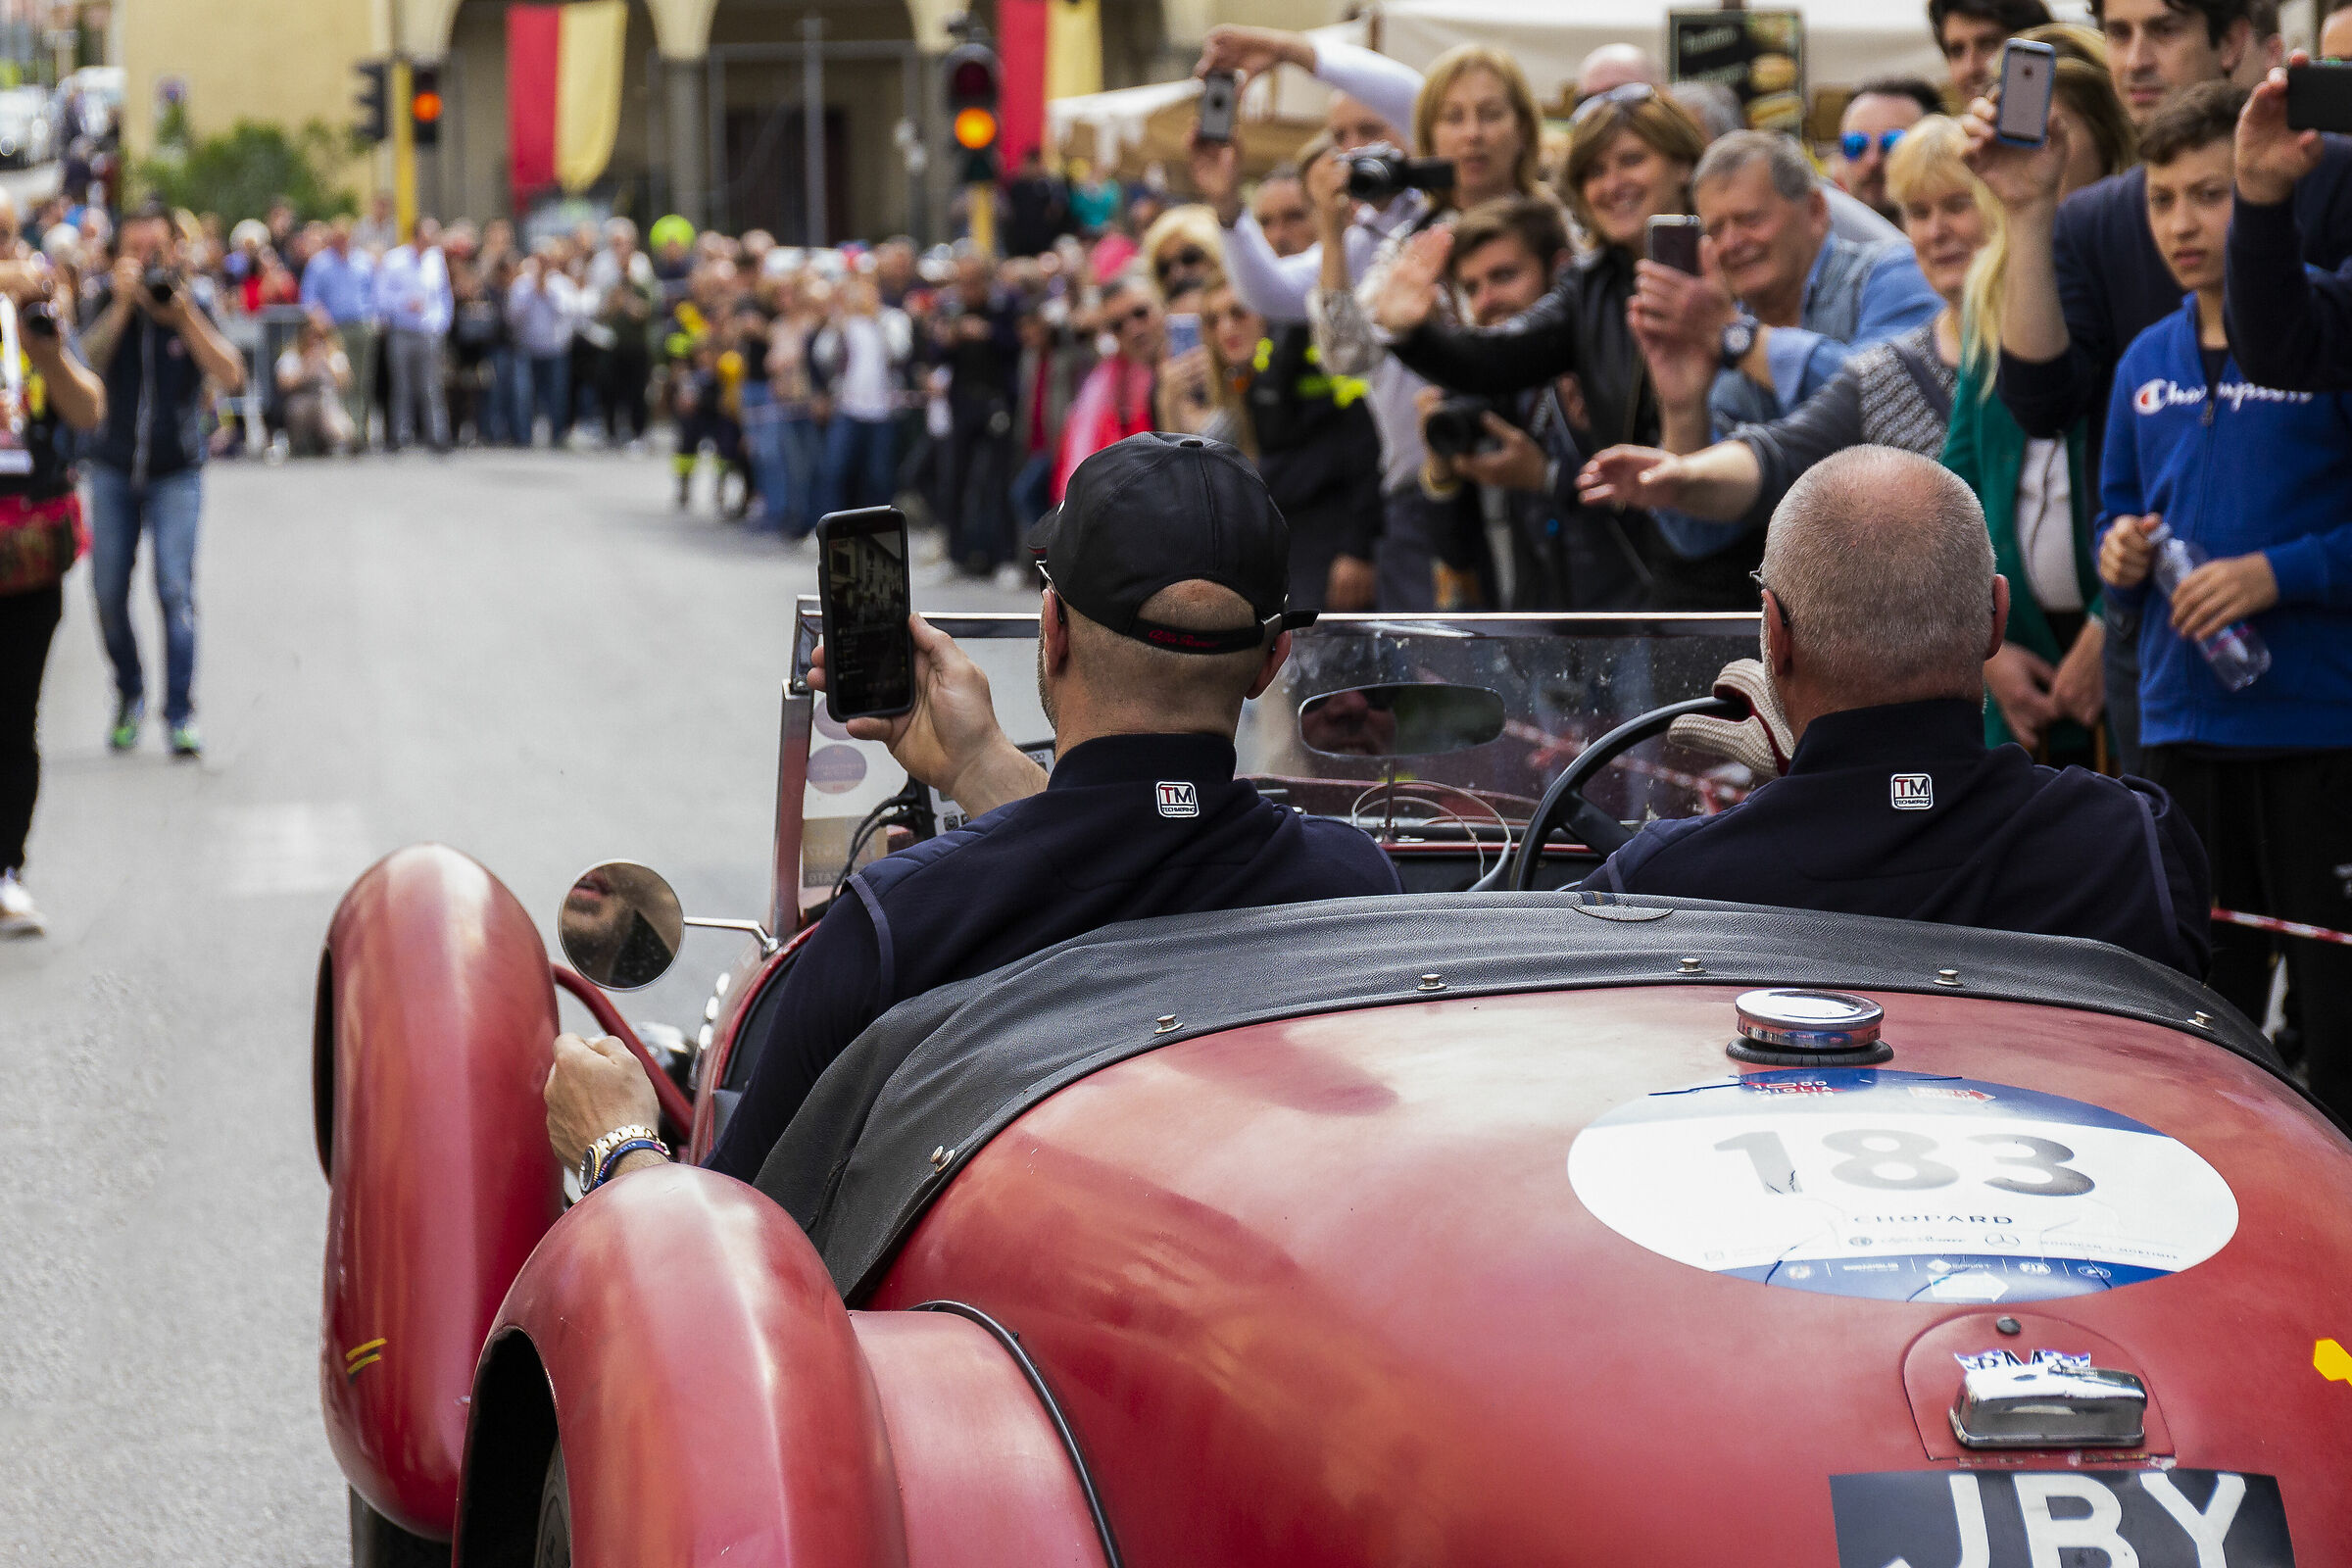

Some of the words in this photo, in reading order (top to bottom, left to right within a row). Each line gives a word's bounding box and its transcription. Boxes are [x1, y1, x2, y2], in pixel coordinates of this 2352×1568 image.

[1159, 786, 1193, 804] TM
[1894, 778, 1928, 797] TM
[1713, 1128, 2096, 1197] 183
[1853, 1214, 2013, 1224] CHOPARD
[1880, 1471, 2248, 1568] JBY
